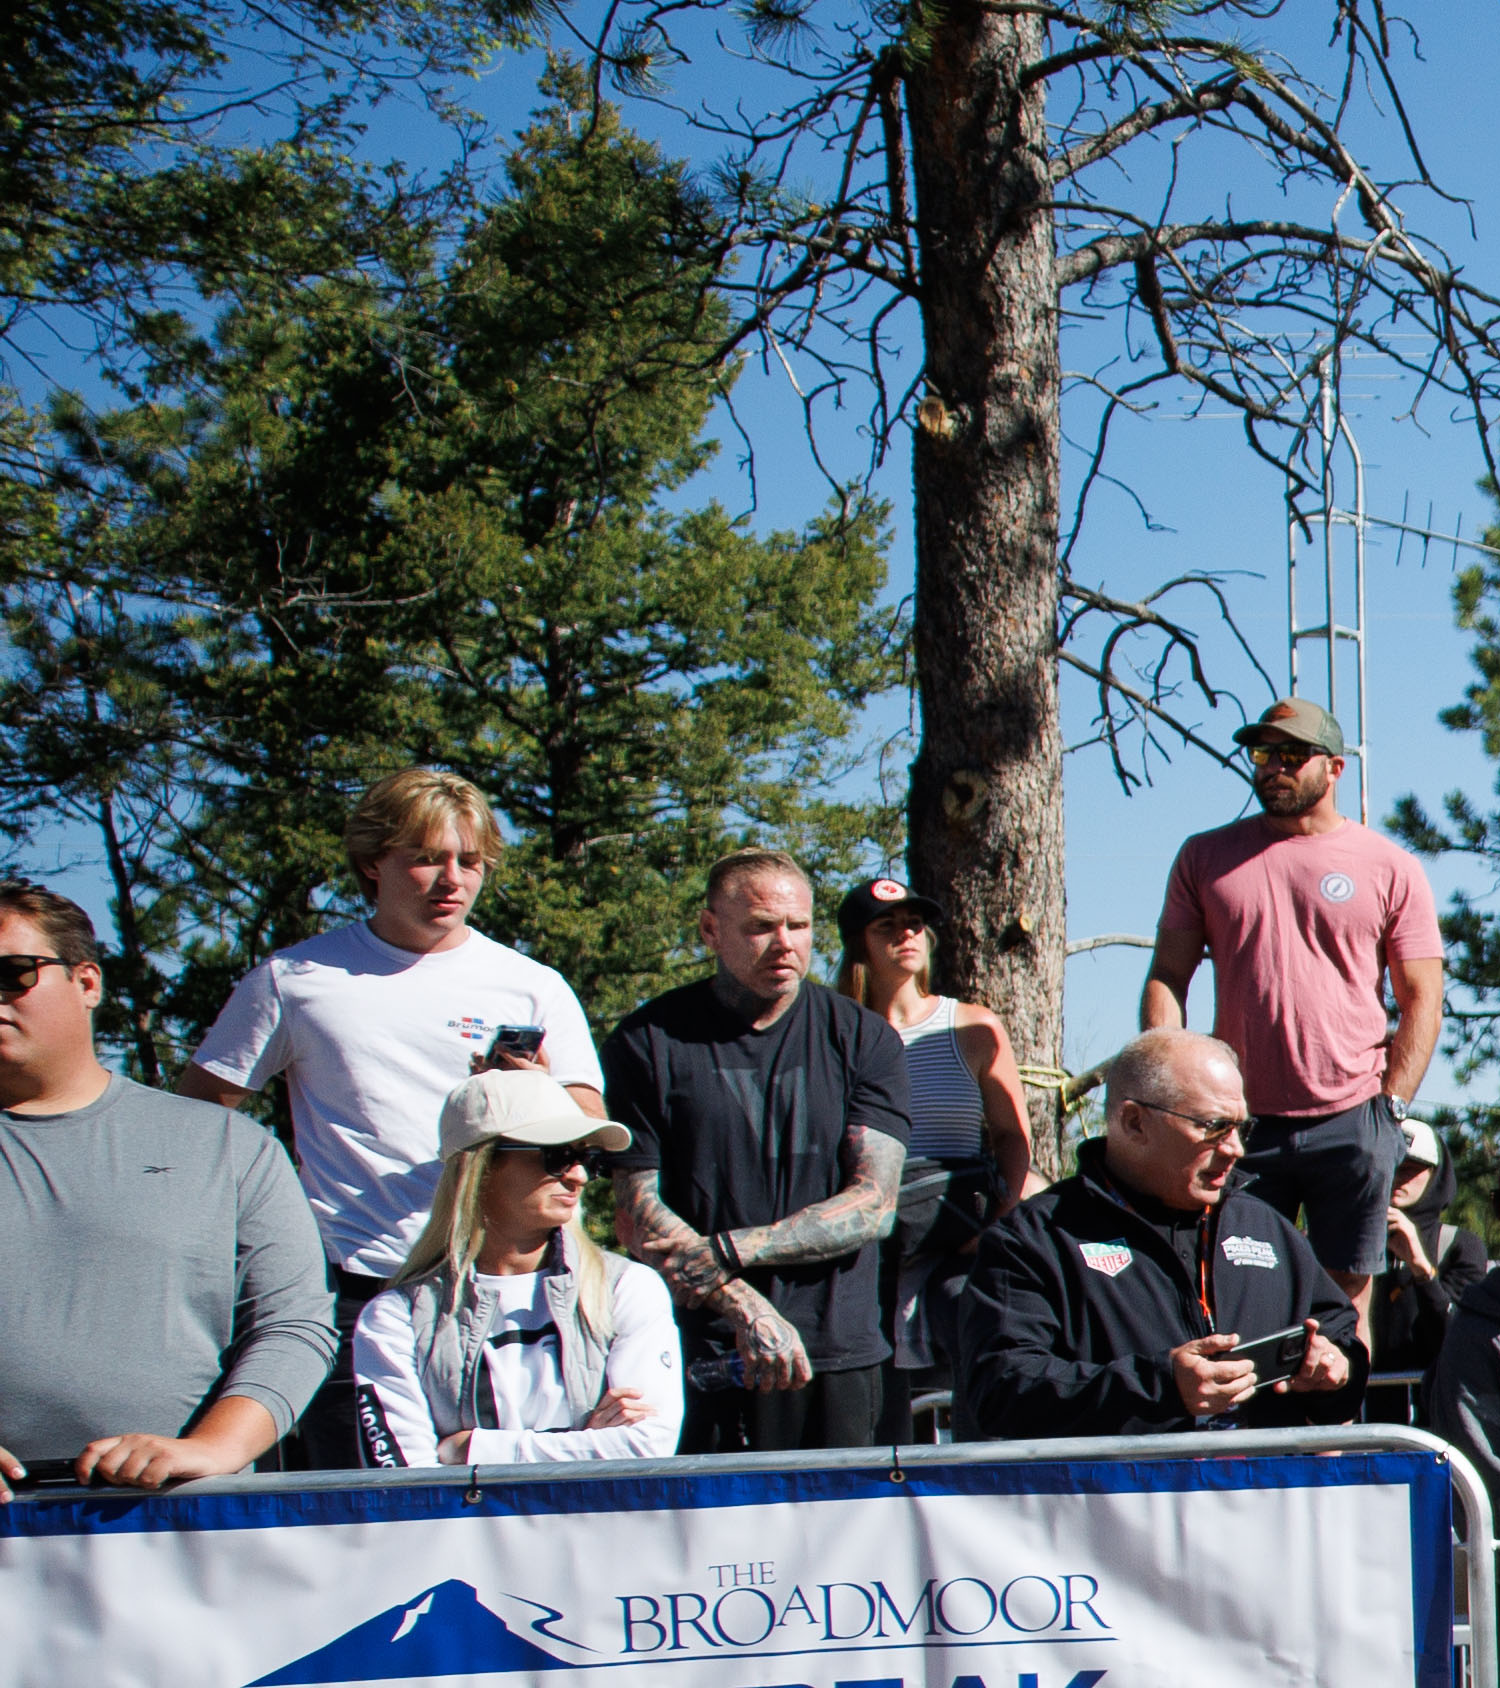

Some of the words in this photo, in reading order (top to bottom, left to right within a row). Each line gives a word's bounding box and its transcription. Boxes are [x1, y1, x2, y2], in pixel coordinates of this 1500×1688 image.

[1087, 1252, 1131, 1275] HEUER
[709, 1561, 777, 1588] THE
[616, 1574, 1113, 1654] BROADMOOR
